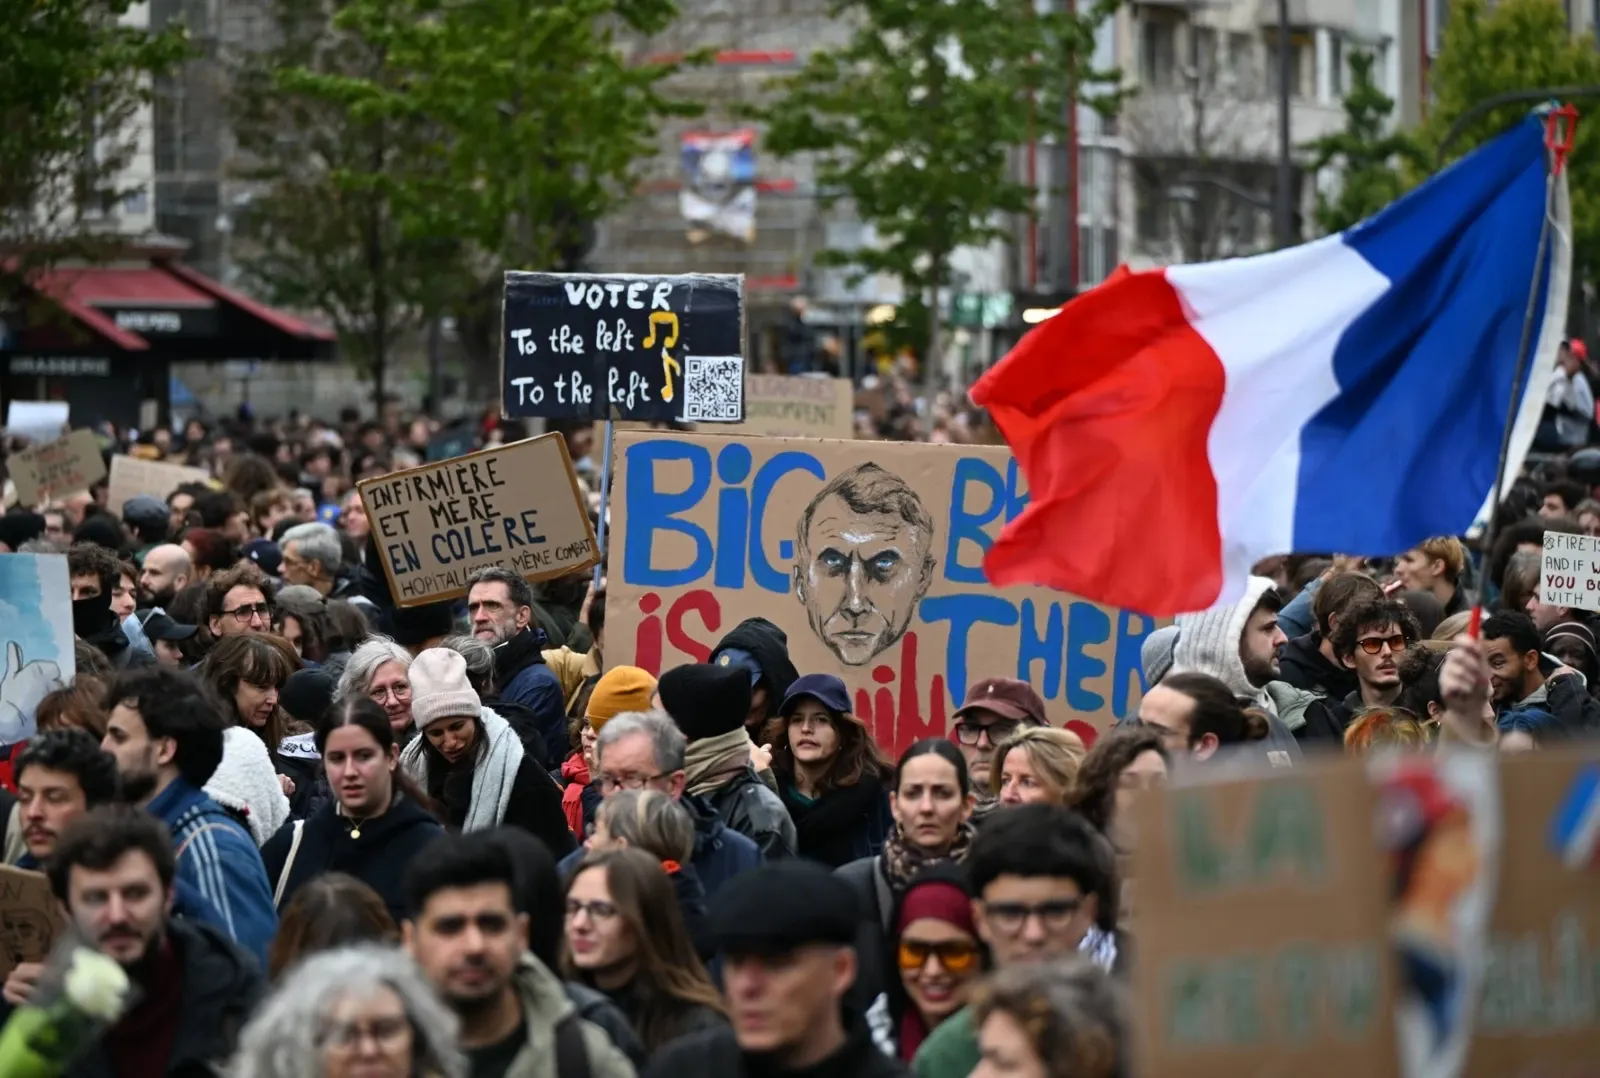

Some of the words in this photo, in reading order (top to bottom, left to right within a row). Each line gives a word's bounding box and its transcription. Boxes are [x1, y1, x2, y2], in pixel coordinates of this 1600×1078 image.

[565, 282, 673, 311] VOTER
[511, 328, 537, 355] To
[549, 325, 585, 354] the
[596, 318, 635, 352] left
[511, 377, 544, 405] To
[554, 371, 592, 404] the
[608, 367, 651, 411] left
[379, 510, 409, 537] ET
[429, 493, 501, 529] MÈRE
[388, 540, 421, 575] EN
[432, 510, 546, 564] COLÈRE
[555, 539, 591, 560] COMBAT
[1557, 535, 1586, 551] FIRE
[1545, 556, 1570, 571] AND
[1574, 560, 1584, 572] IF
[1546, 575, 1576, 589] YOU
[1547, 591, 1584, 605] WITH
